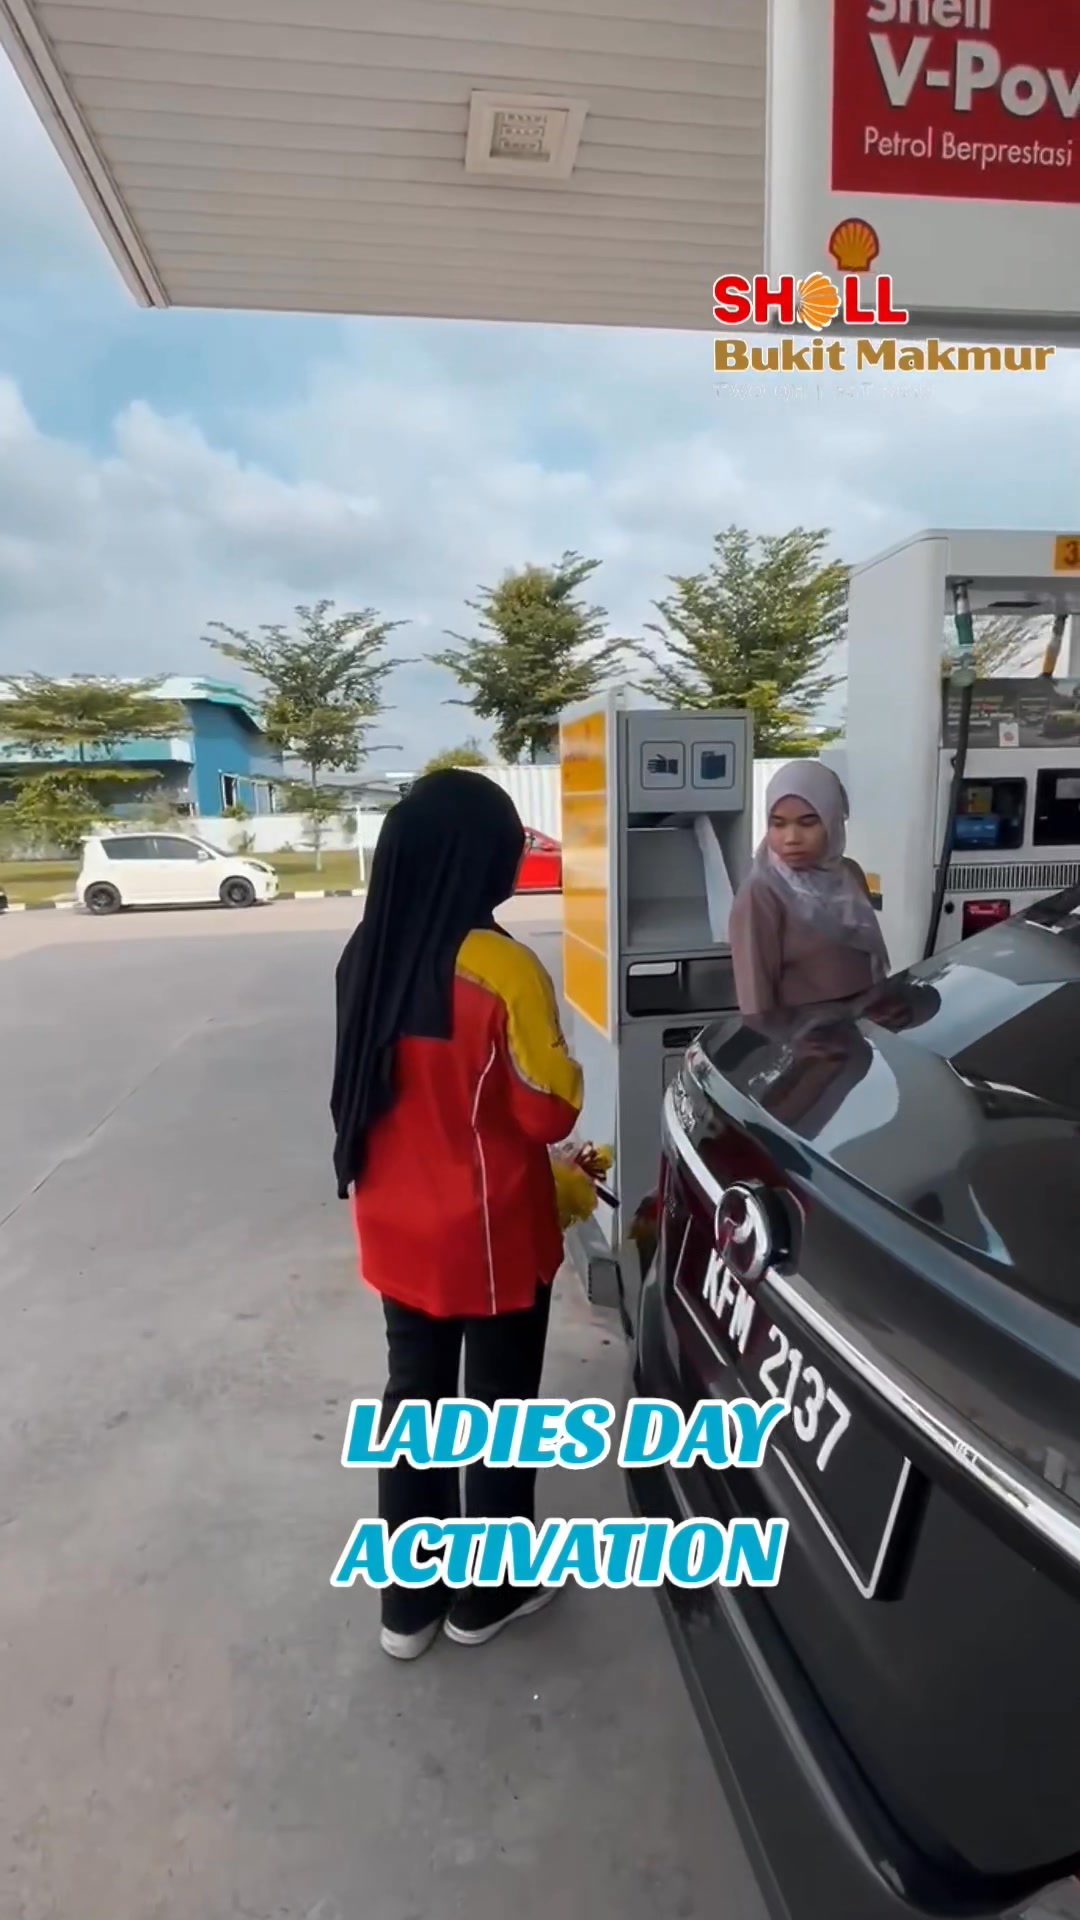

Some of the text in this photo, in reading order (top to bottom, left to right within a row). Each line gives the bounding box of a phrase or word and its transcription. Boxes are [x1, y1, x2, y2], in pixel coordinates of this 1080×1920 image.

[864, 125, 1073, 170] Petrol Berprestasi
[1064, 540, 1079, 566] 3
[759, 1324, 851, 1472] 2137
